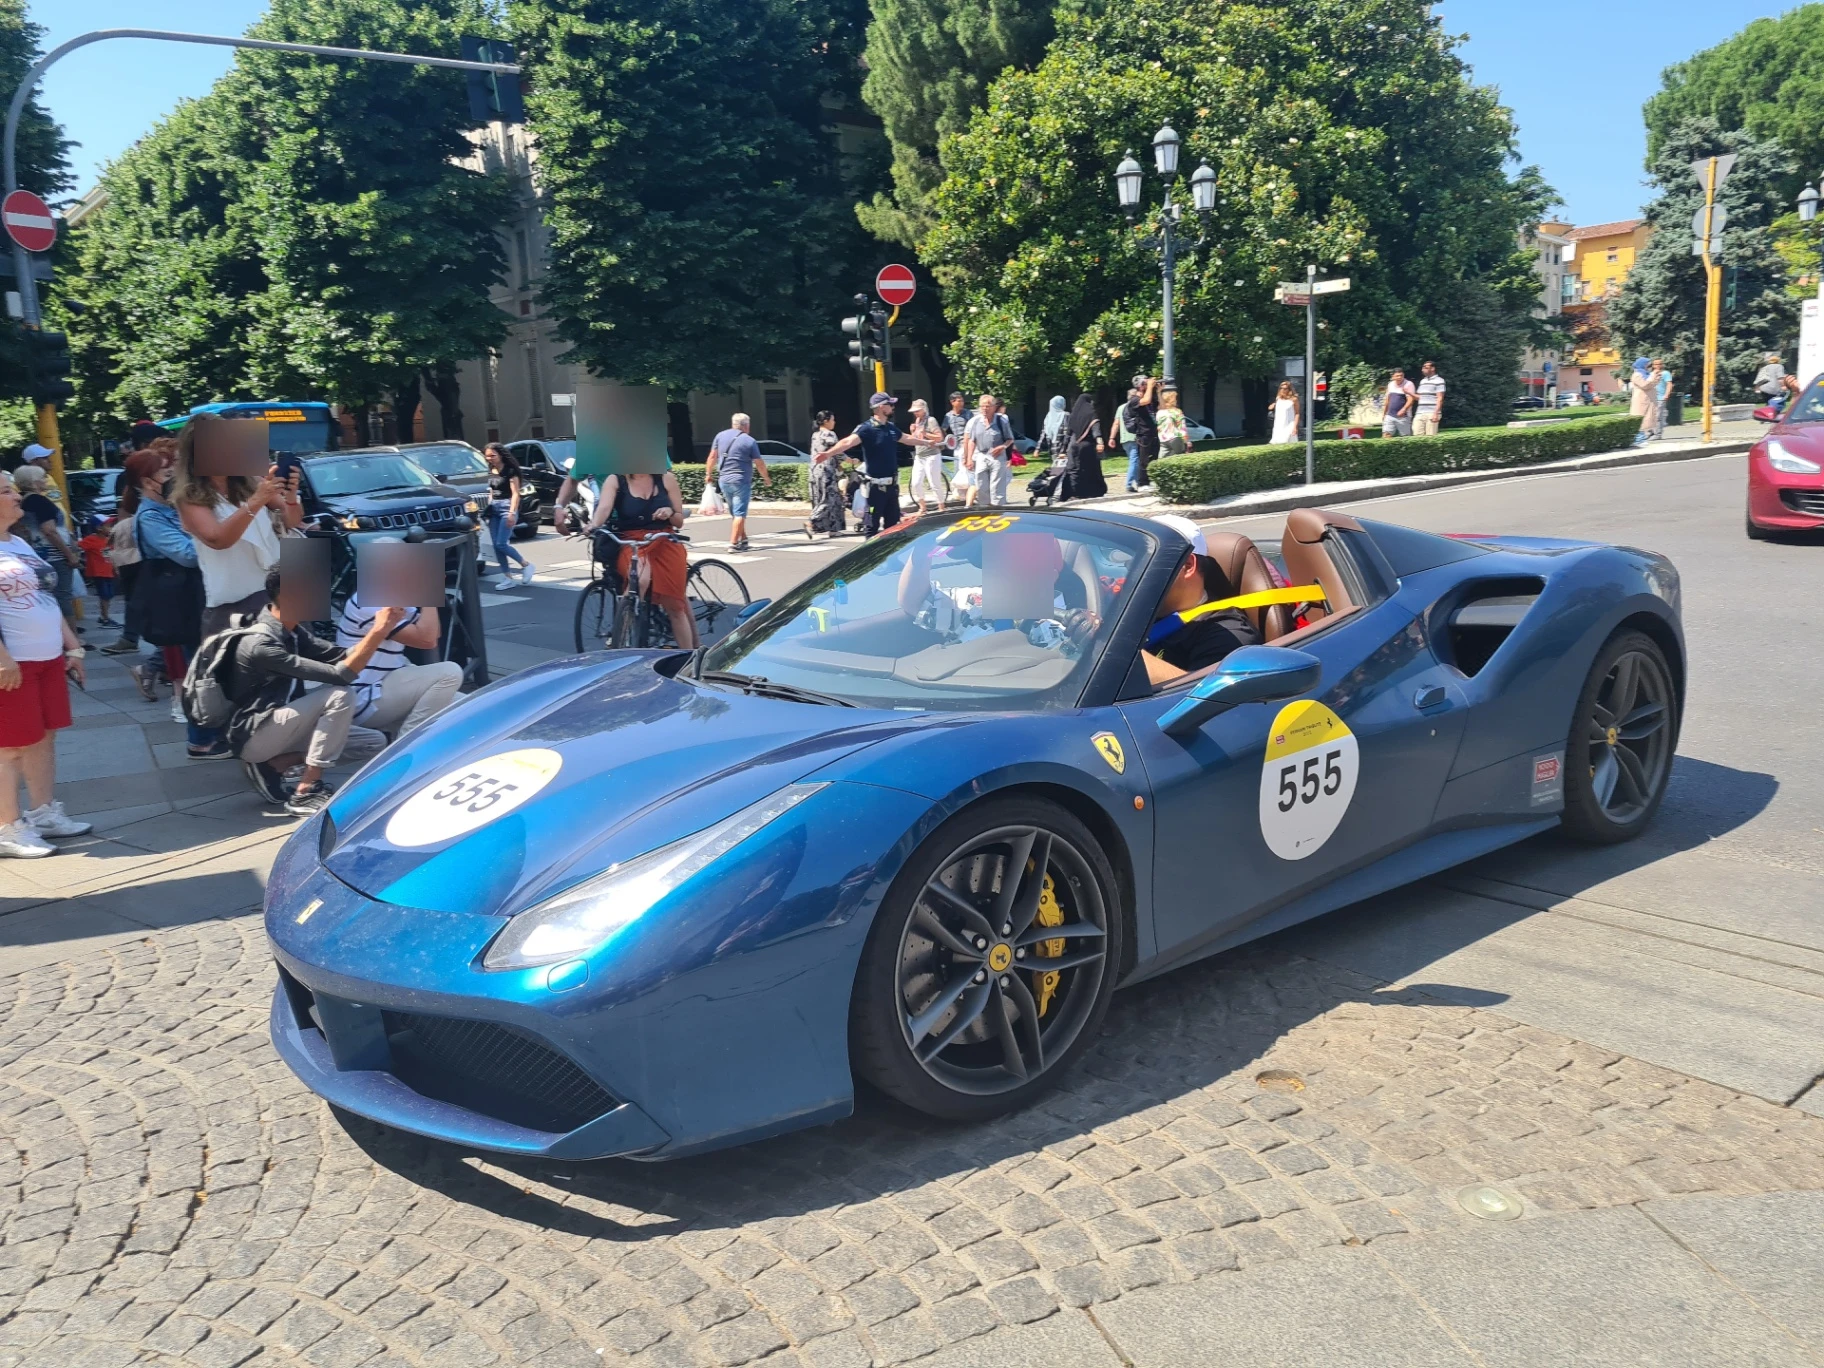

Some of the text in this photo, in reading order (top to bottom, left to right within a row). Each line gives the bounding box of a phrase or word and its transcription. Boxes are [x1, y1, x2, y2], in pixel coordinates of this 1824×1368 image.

[948, 515, 1020, 532] 555
[433, 773, 519, 812] 555
[1278, 749, 1342, 813] 555
